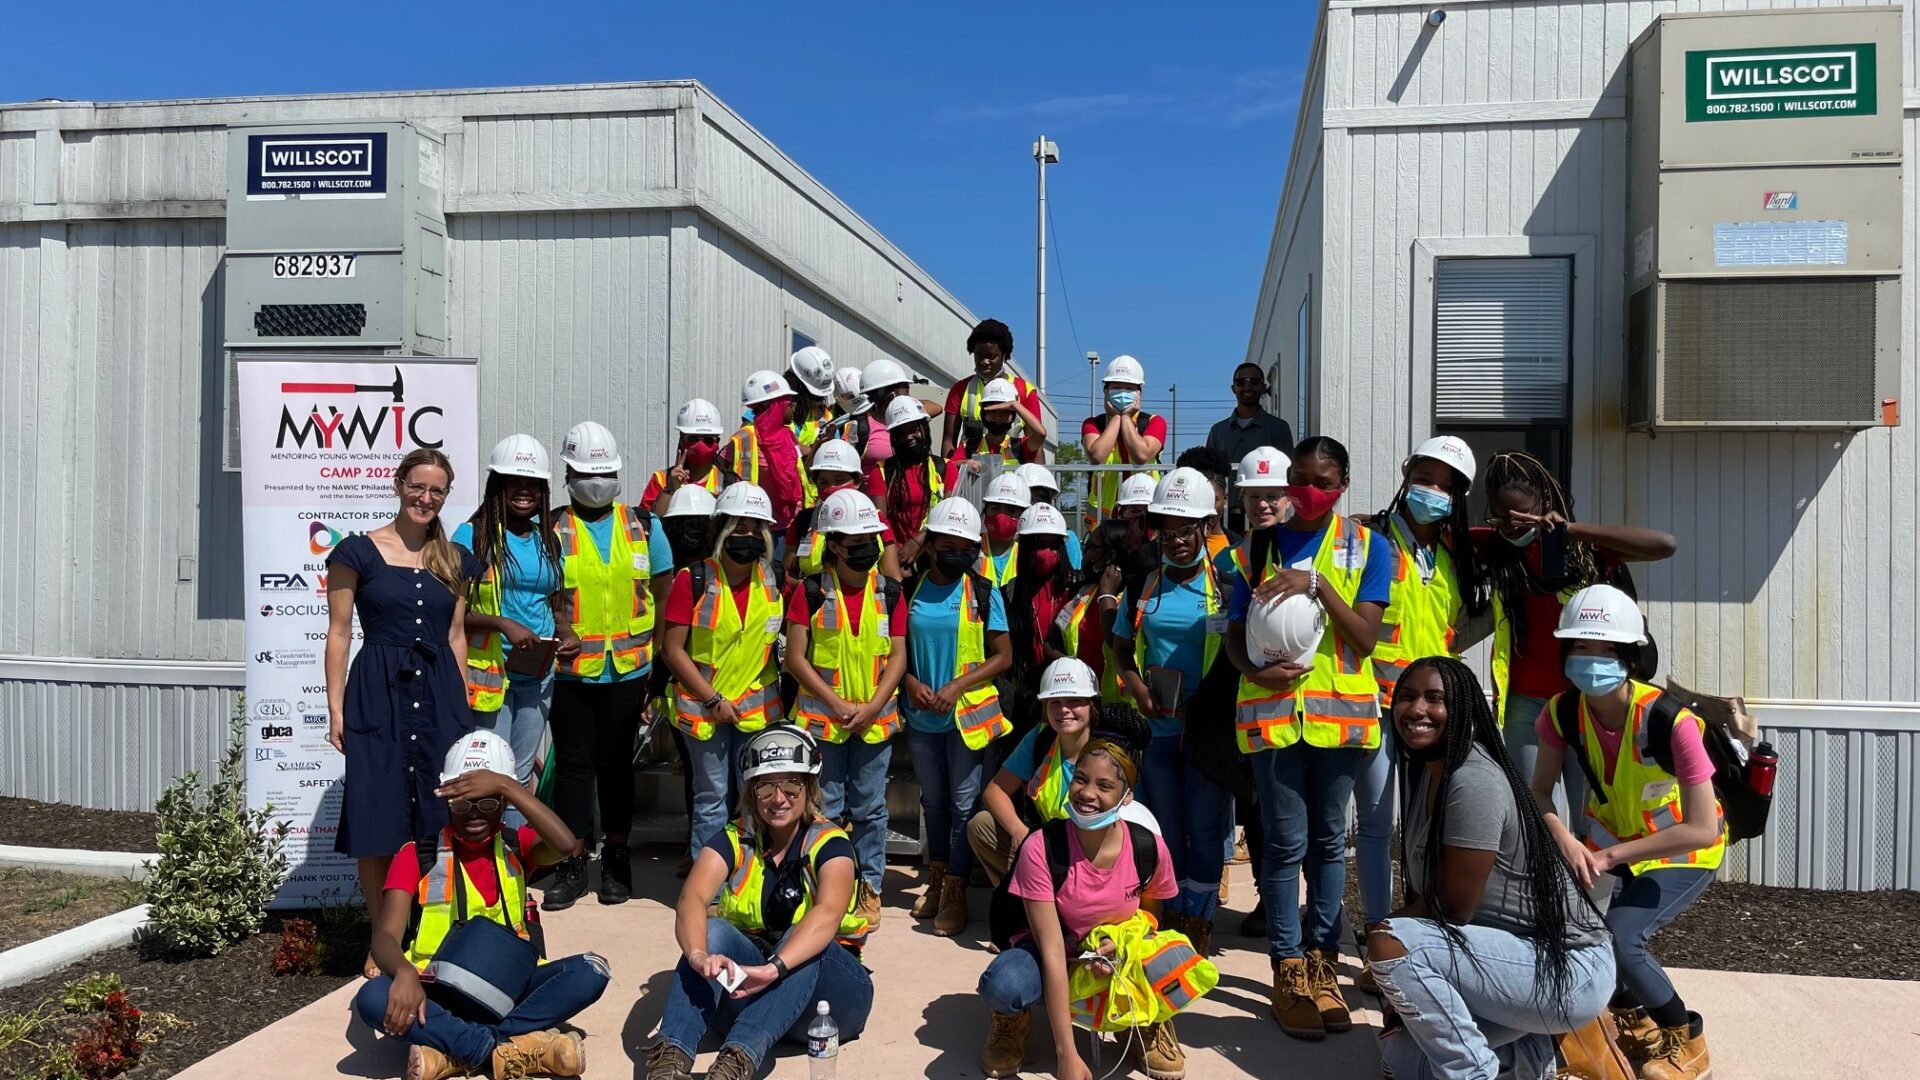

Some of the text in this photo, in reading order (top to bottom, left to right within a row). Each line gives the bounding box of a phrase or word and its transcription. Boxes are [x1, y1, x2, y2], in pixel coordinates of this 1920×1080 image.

[1719, 65, 1844, 86] WILLSCOT
[1706, 100, 1856, 114] 800.782.1500 WILLSCOT.COM
[271, 150, 363, 166] WILLSCOT
[261, 179, 372, 189] 800.782.1500 WILLSCOT.COM
[274, 255, 354, 276] 682937
[320, 467, 398, 478] CAMP 2022
[306, 484, 314, 492] by
[298, 512, 370, 520] CONTRACTOR
[260, 573, 309, 588] FPA
[276, 605, 329, 616] SOCIUS
[305, 716, 326, 724] MRG
[261, 723, 293, 739] gbca
[255, 748, 273, 760] RT
[277, 761, 322, 771] SEAMLESS
[299, 780, 337, 788] SAFETY
[315, 826, 338, 834] THAN
